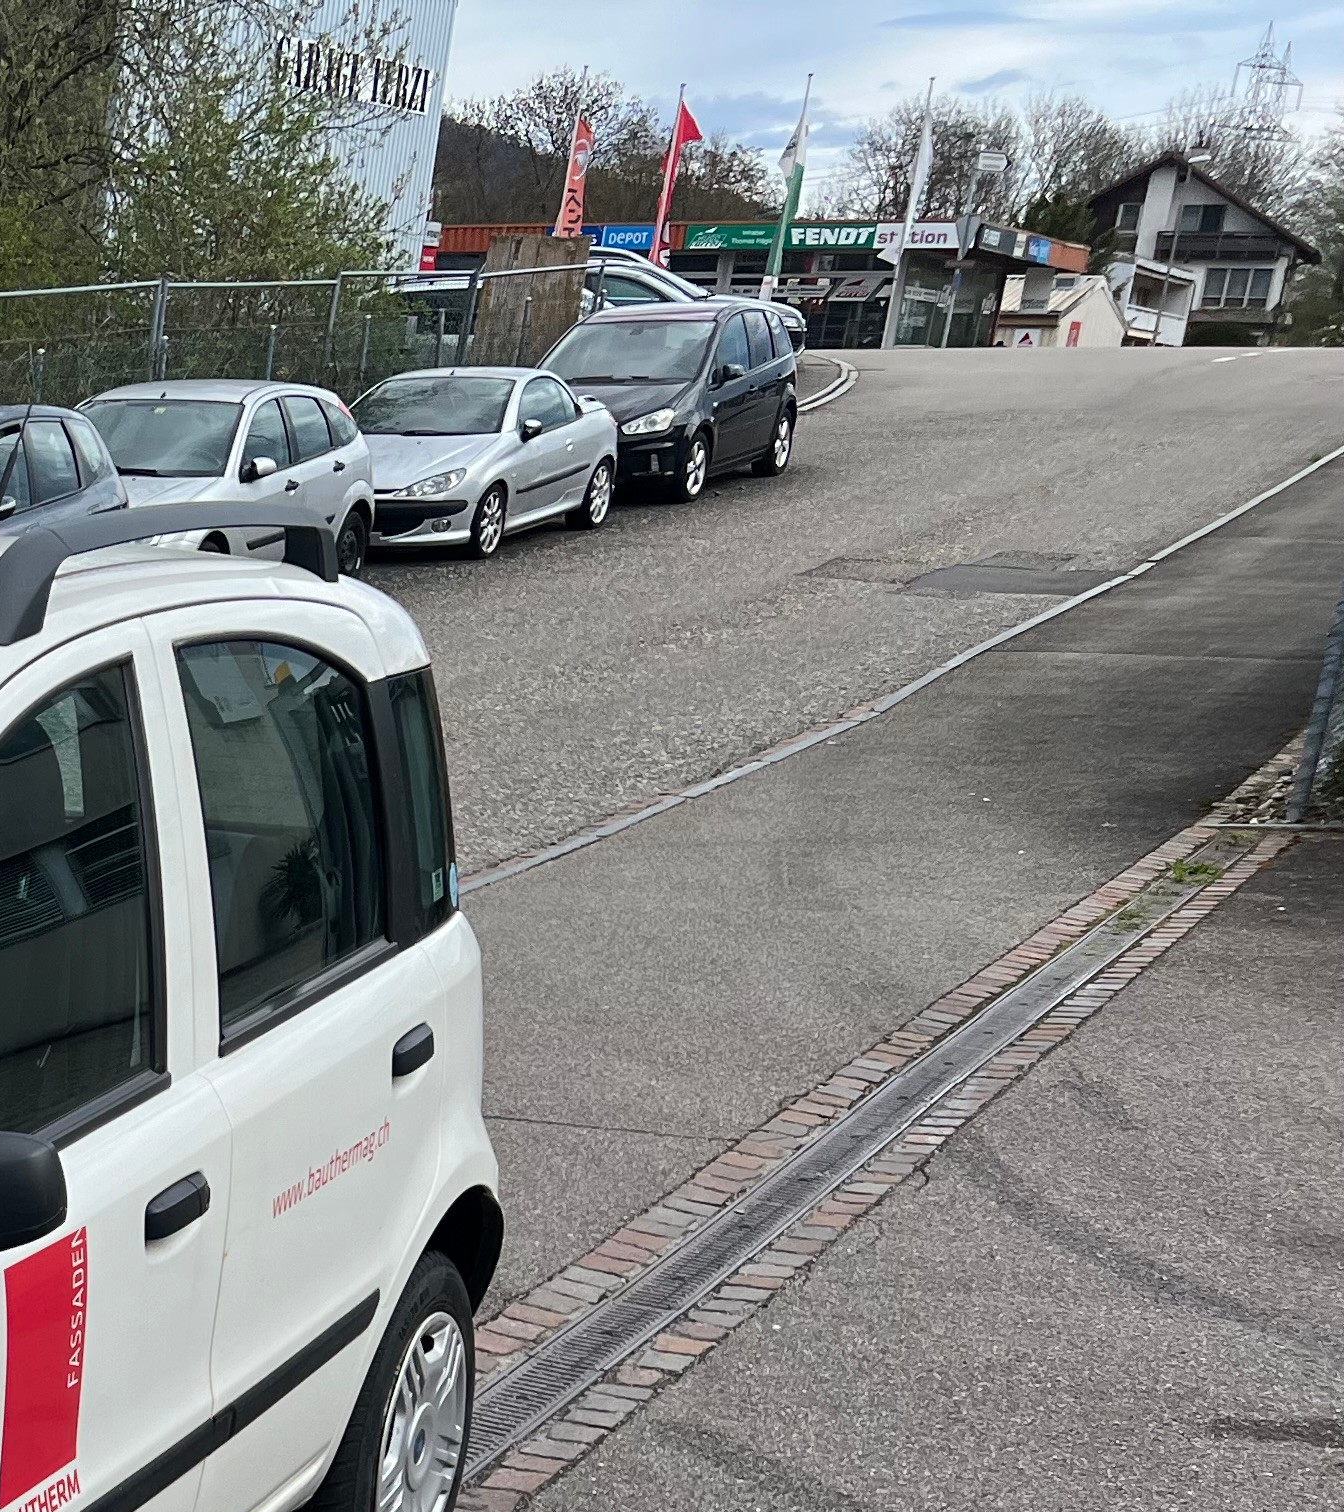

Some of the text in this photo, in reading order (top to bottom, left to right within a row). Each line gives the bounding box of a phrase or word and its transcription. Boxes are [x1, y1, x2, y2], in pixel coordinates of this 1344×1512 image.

[369, 57, 430, 113] TERZI
[790, 226, 948, 246] FENDT sttion
[272, 1115, 390, 1219] www.bauthermag.ch
